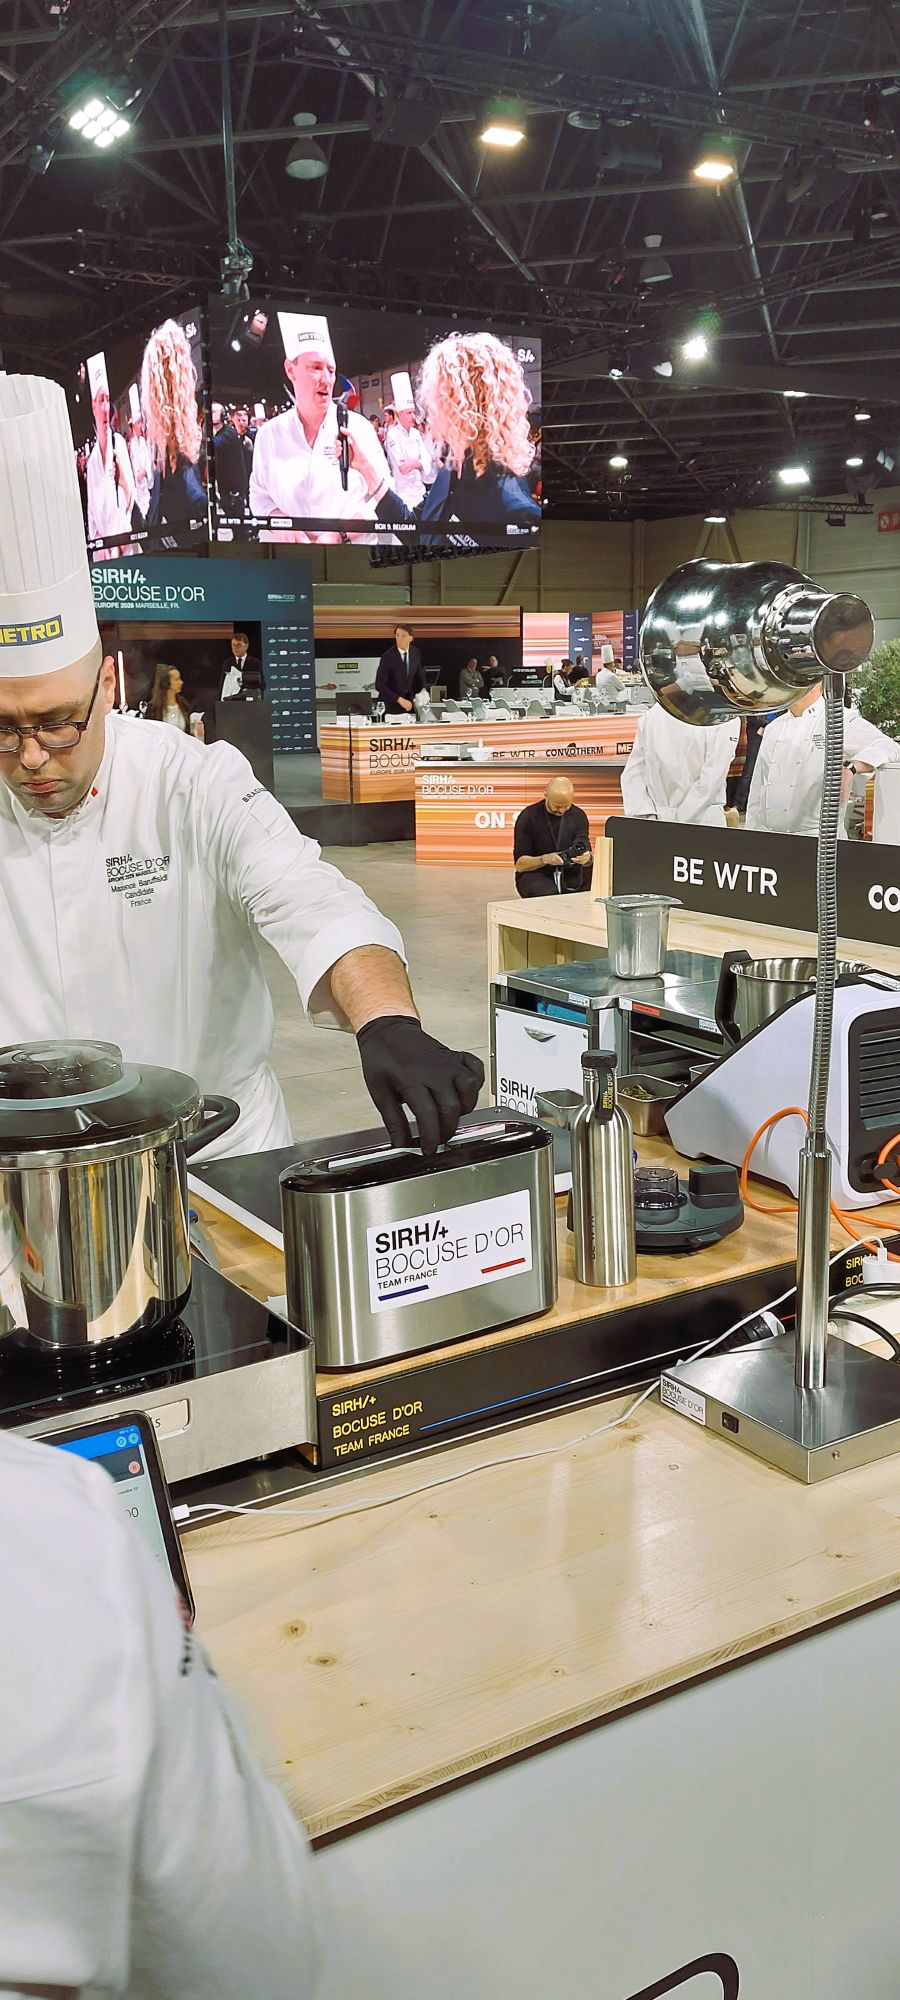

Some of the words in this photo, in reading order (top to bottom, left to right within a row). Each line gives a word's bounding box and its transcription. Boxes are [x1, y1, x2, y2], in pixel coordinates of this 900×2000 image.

[393, 523, 416, 531] BELGIUM
[92, 585, 162, 601] BOCUSE
[165, 586, 205, 602] D'OR
[545, 746, 604, 757] CONVOTHERM
[422, 785, 465, 795] BOCUSE
[475, 811, 506, 829] ON
[106, 861, 144, 878] BOCUSE
[144, 855, 170, 869] D'OR
[673, 855, 704, 886] BE
[713, 861, 778, 898] WTR
[125, 887, 155, 899] Candidate
[130, 898, 152, 908] France
[376, 1237, 469, 1279] BOCUSE
[475, 1222, 524, 1254] D'OR
[377, 1278, 402, 1290] TEAM
[404, 1268, 438, 1284] FRANCE
[662, 1386, 687, 1406] BOCUSE
[332, 1411, 387, 1439] BOCUSE
[392, 1400, 423, 1421] D'OR
[333, 1438, 364, 1457] TEAM
[368, 1424, 410, 1447] FRANCE
